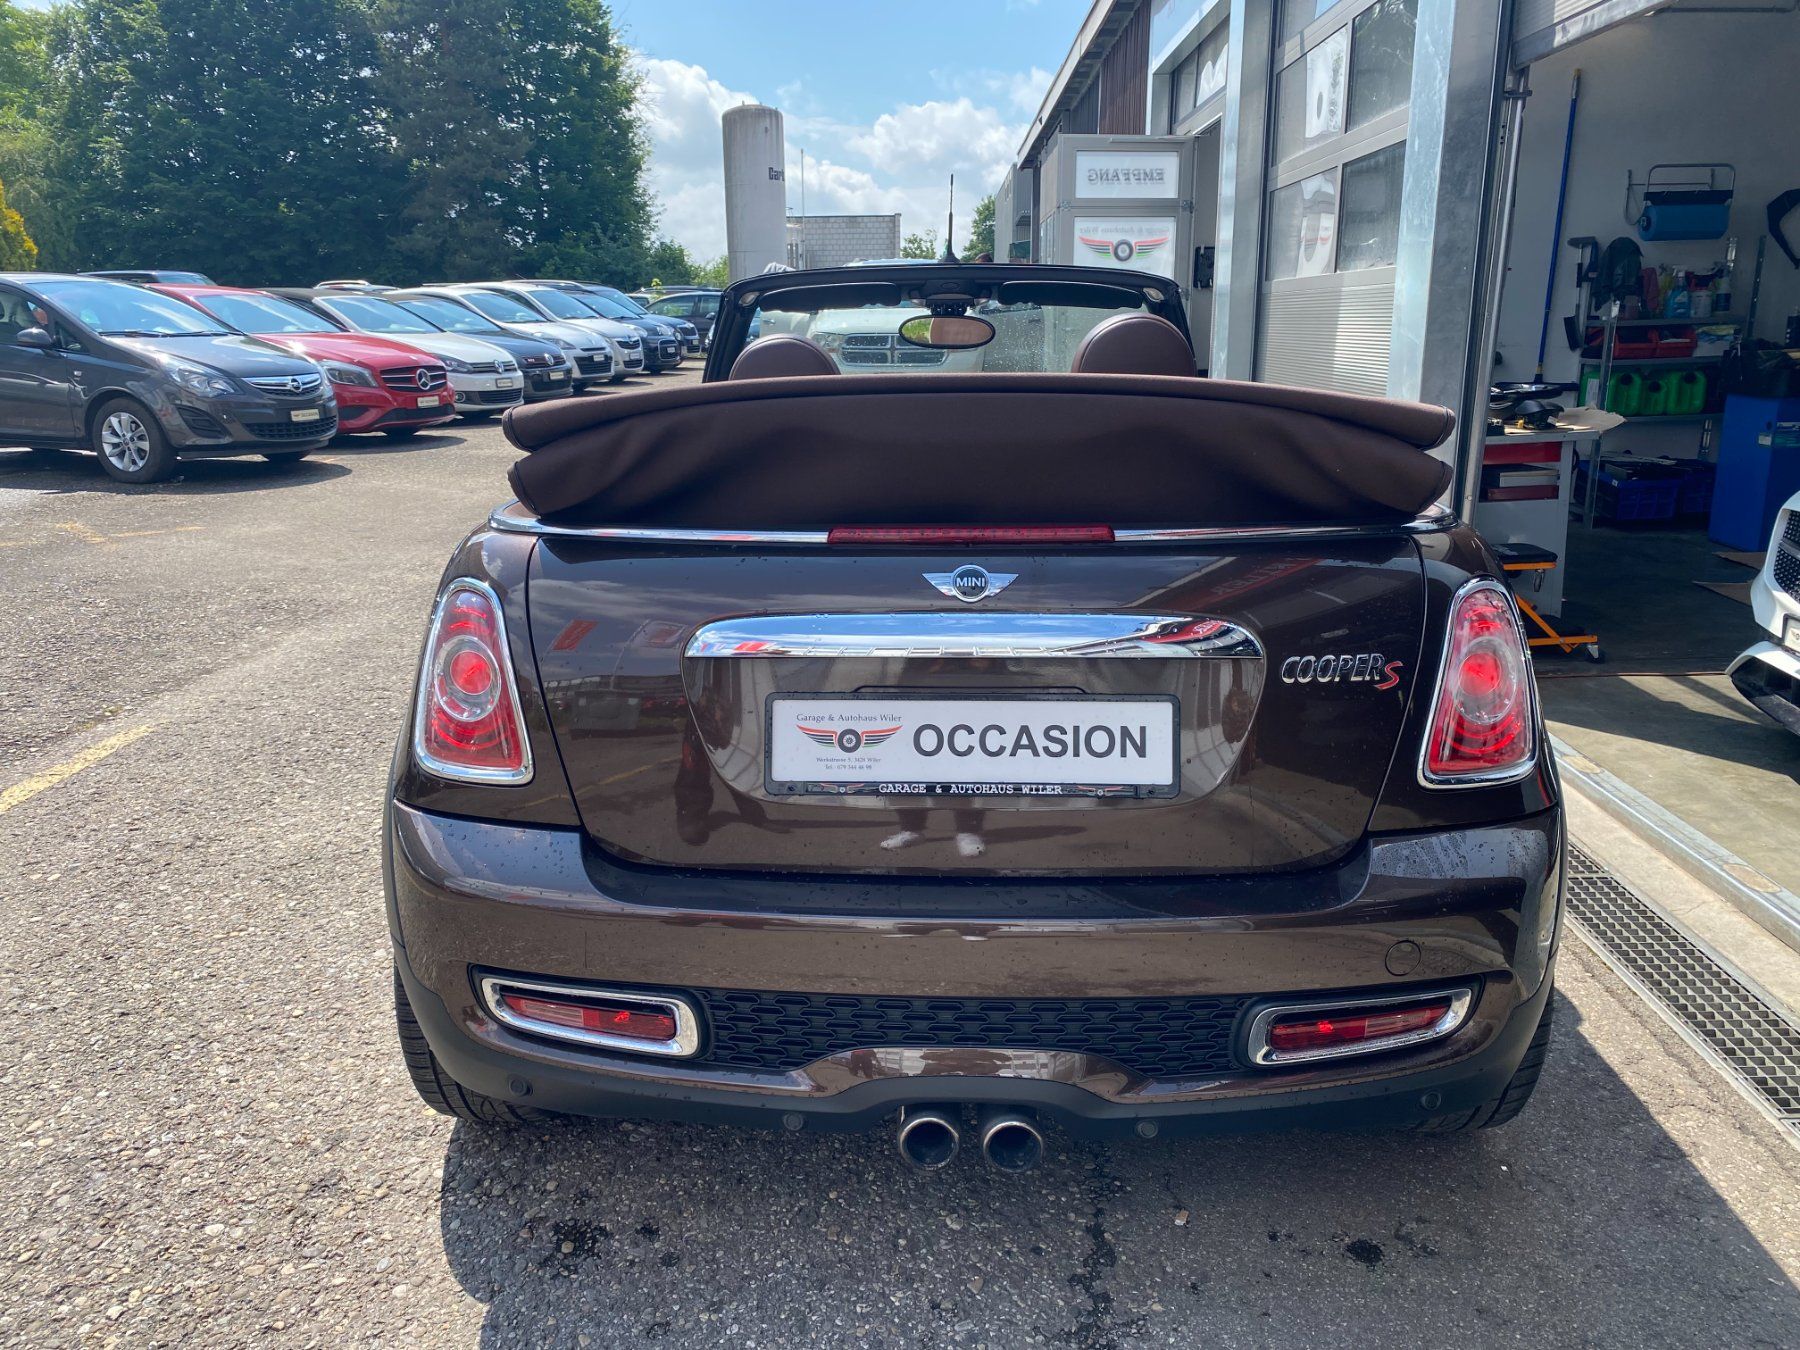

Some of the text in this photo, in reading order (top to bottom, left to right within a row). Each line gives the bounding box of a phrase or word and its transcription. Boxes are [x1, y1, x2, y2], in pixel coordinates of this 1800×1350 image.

[956, 577, 985, 587] MINI
[1281, 653, 1404, 690] COOPER S
[796, 713, 826, 723] Garage
[838, 714, 877, 722] Autohaus
[880, 714, 902, 722] Wiler
[913, 723, 1147, 759] OCCASION
[878, 783, 1063, 794] GARAGE & AUTOHAUS WILER
